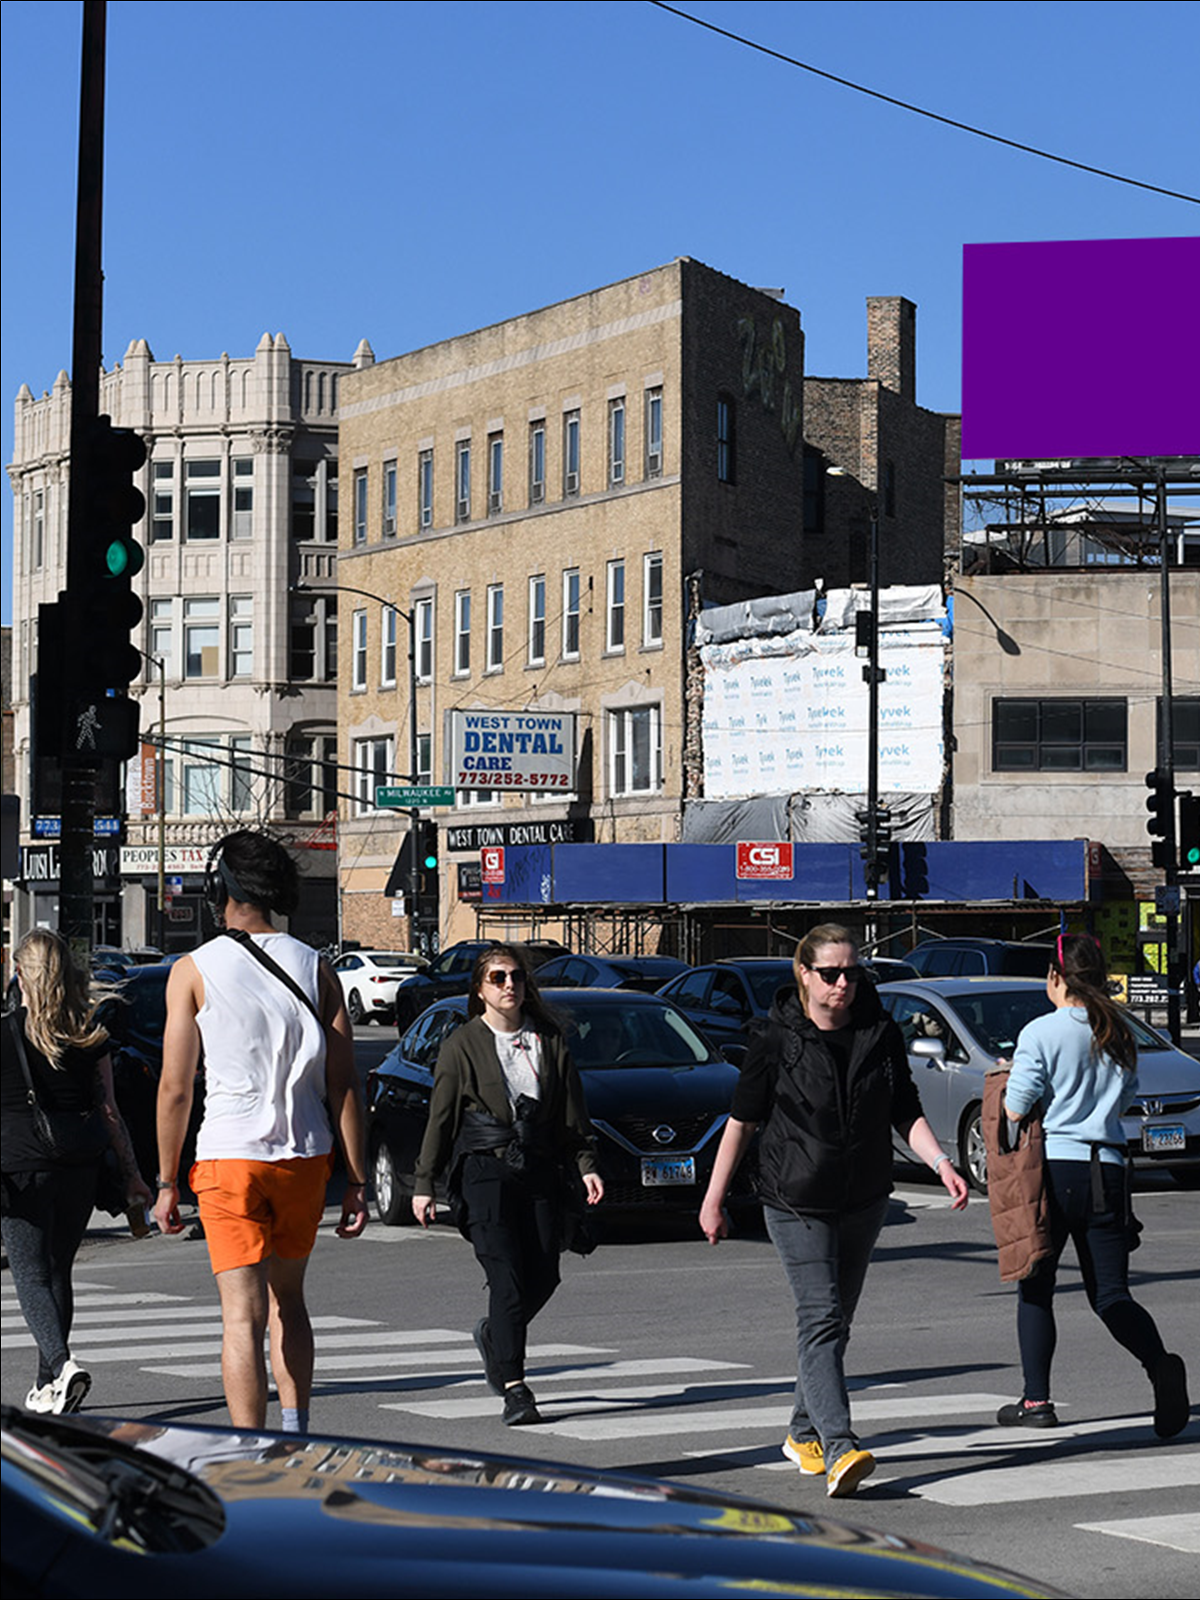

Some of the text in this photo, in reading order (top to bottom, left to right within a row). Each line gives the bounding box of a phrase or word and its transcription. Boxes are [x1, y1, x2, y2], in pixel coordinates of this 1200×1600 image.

[880, 705, 911, 719] yvek
[466, 717, 562, 730] WEST TOWN
[464, 732, 563, 754] DENTAL
[879, 744, 910, 758] yvek
[463, 756, 512, 770] CARE
[458, 772, 569, 786] 773/252-5772
[387, 789, 441, 797] MILWAUKEE
[449, 822, 575, 846] WEST TOWN DENTAL CARE
[181, 849, 203, 861] TAX
[749, 848, 779, 865] CSI
